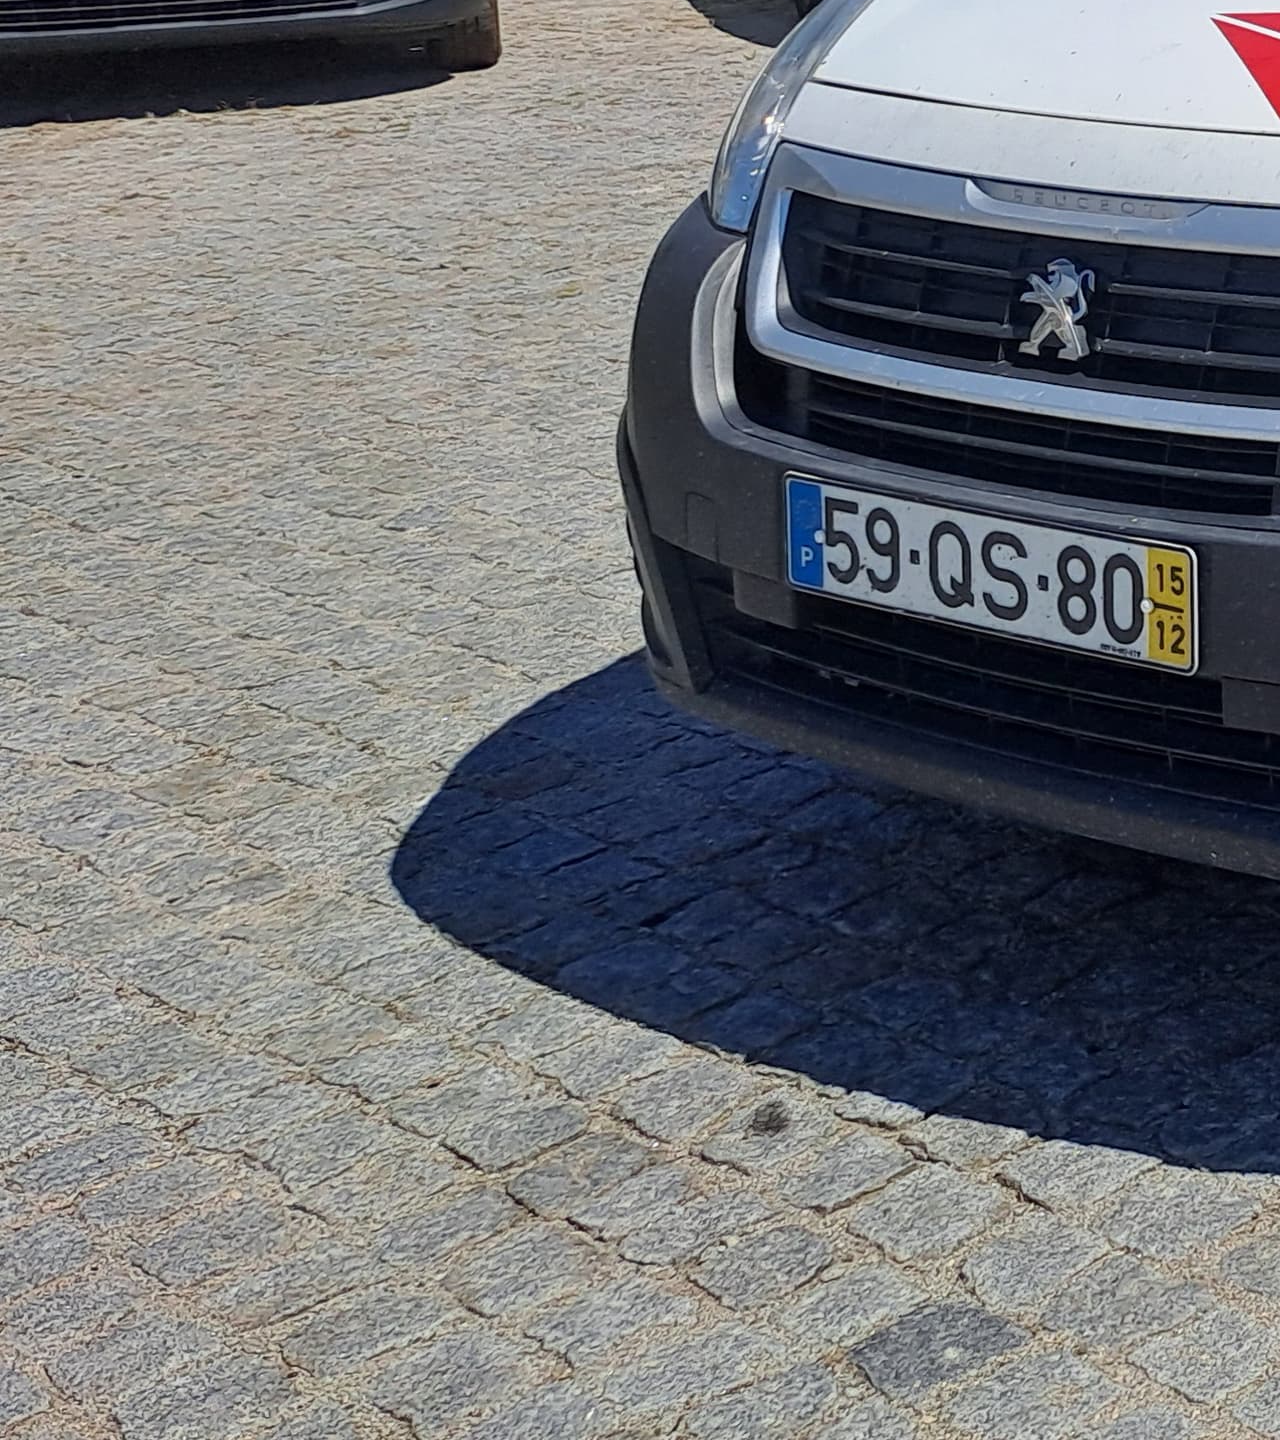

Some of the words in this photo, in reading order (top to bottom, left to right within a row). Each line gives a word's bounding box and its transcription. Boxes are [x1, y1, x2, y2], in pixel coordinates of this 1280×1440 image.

[801, 546, 814, 567] P
[1155, 563, 1185, 596] 15
[1156, 620, 1186, 655] 12
